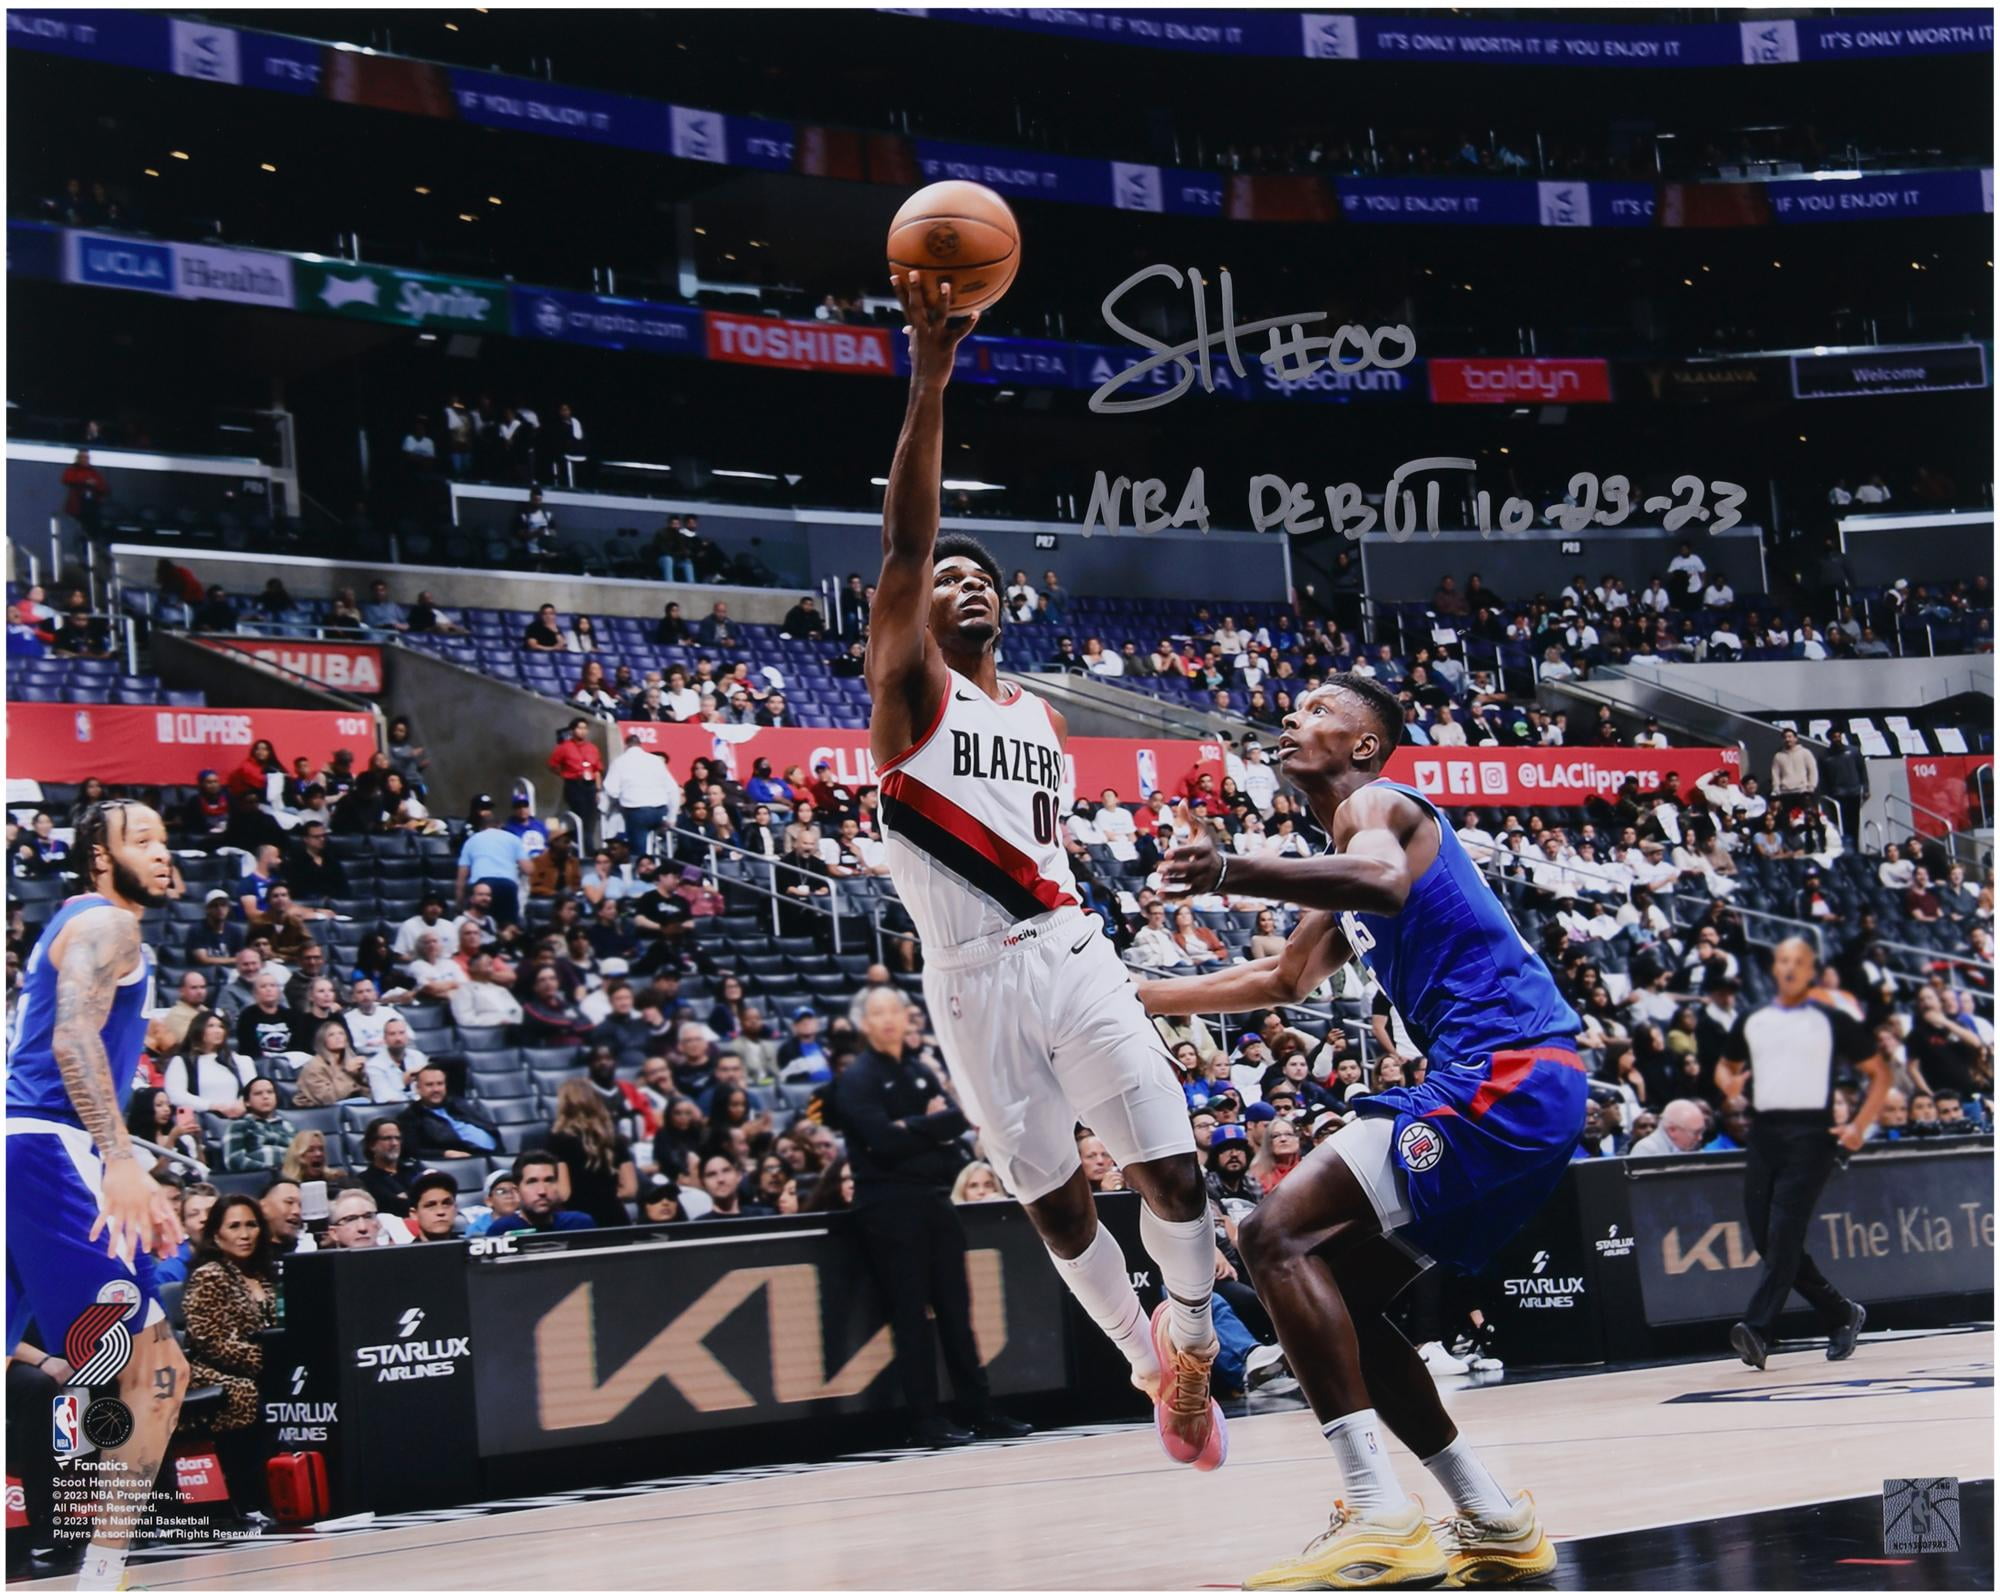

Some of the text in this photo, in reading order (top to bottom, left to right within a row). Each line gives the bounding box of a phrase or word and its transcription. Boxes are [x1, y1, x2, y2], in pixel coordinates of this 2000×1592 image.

[1127, 18, 1162, 37] YOU
[1164, 22, 1222, 42] ENJOY
[1225, 26, 1243, 43] IT
[1819, 32, 1853, 50] IT'S
[1856, 30, 1904, 48] ONLY
[1906, 25, 1975, 46] WORTH
[1378, 32, 1681, 58] IT'S ONLY WORTH IT IF YOU ENJOY IT
[983, 166, 1039, 188] ENJOY
[1364, 195, 1401, 212] YOU
[1404, 196, 1460, 213] ENJOY
[1796, 196, 1836, 212] YOU
[1840, 192, 1900, 210] ENJOY
[1903, 189, 1920, 206] IT
[87, 248, 285, 297] UCLA Health
[396, 281, 491, 321] Sprite
[568, 310, 689, 341] crypto.com
[712, 322, 887, 368] TOSHIBA
[991, 352, 1067, 375] ULTRA
[1852, 366, 1928, 384] Welcome
[1263, 362, 1401, 398] Spectrum
[1462, 363, 1582, 398] boldyn
[1080, 466, 1210, 538] NBA
[1248, 457, 1478, 543] DEBUT
[222, 647, 379, 689] SHIBA
[177, 712, 253, 746] CLIPPERS
[335, 718, 367, 735] 101
[949, 728, 1064, 793] BLAZERS
[1912, 763, 1937, 778] 104
[1003, 927, 1038, 949] ripcity
[1595, 1235, 1636, 1252] STARLUX
[1820, 1211, 1891, 1261] The
[1896, 1205, 1954, 1255] Kia
[468, 1236, 519, 1256] anc
[1503, 1275, 1586, 1297] STARLUX
[1518, 1295, 1575, 1309] AIRLINES
[356, 1335, 472, 1369] STARLUX
[377, 1360, 456, 1384] AIRLINES
[265, 1402, 339, 1424] STARLUX
[277, 1427, 328, 1442] AIRLINES
